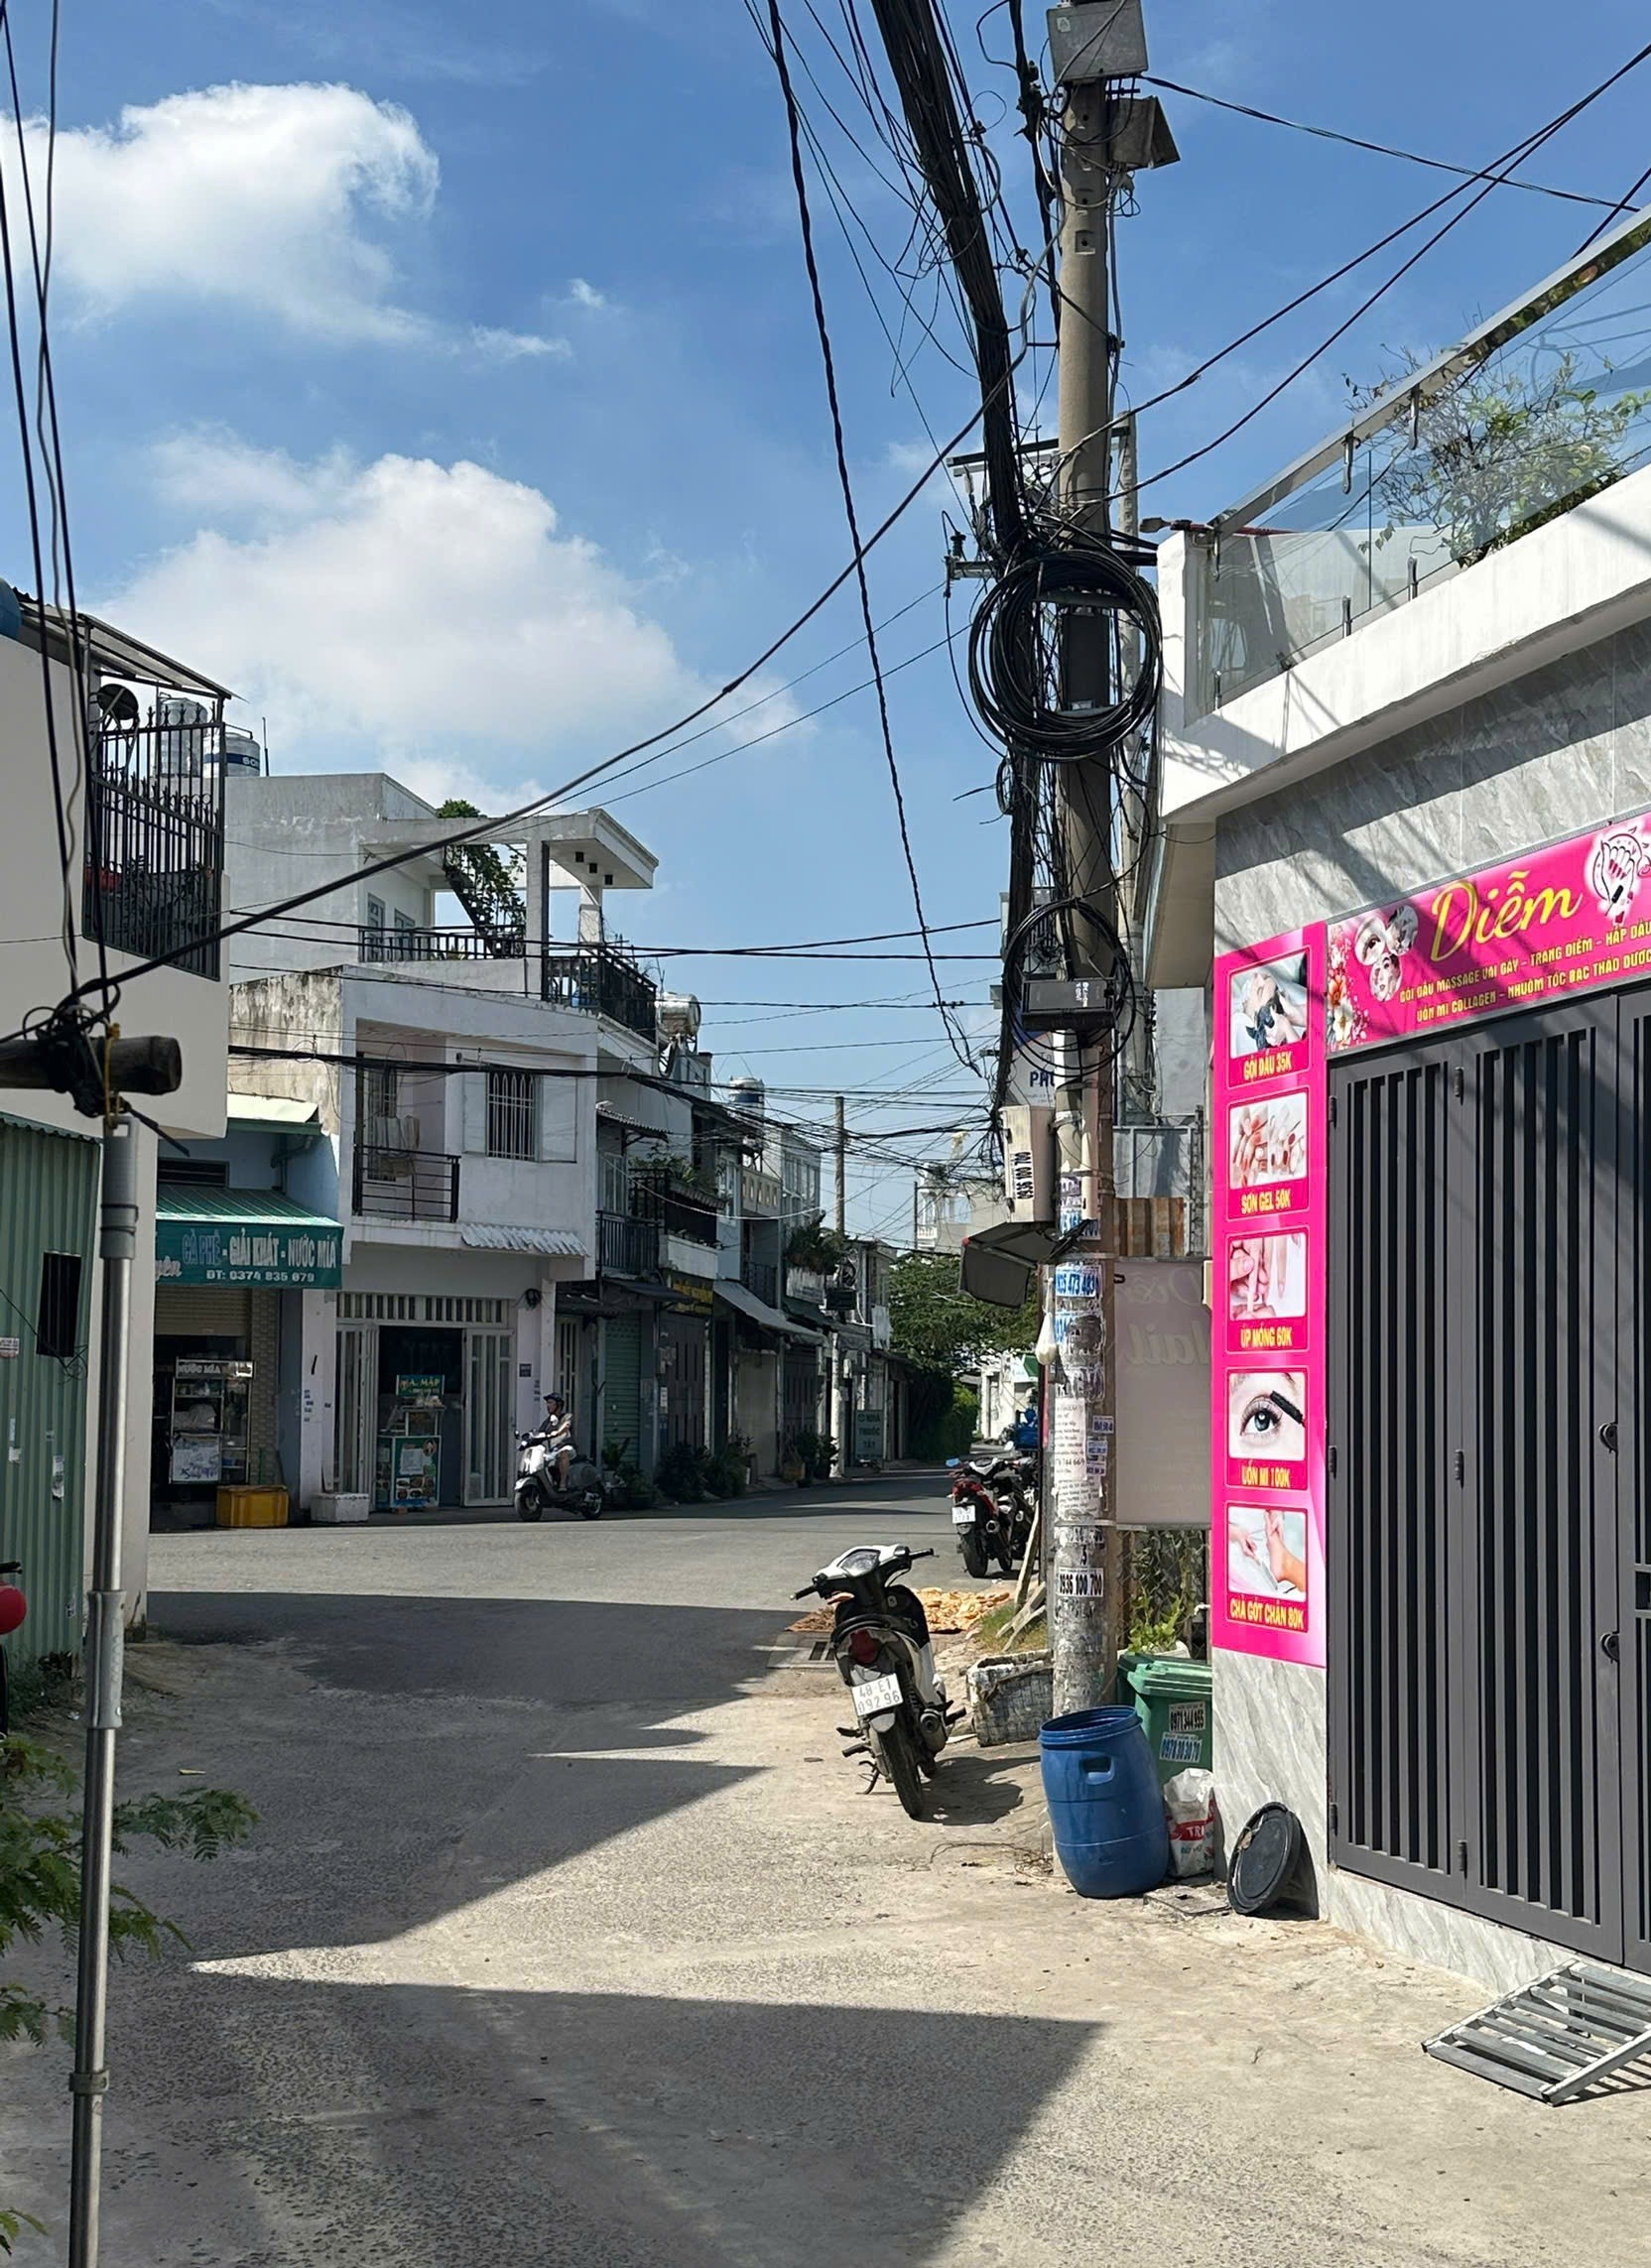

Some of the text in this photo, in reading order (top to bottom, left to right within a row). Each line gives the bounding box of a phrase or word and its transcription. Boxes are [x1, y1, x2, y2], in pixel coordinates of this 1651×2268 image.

[1431, 870, 1583, 961] Diễm
[1437, 969, 1480, 993] MASSAGE
[1482, 964, 1497, 980] VAI
[1530, 945, 1563, 967] TRANG
[1452, 991, 1496, 1013] COLLAGEN
[1259, 1191, 1275, 1212] GEL
[229, 1270, 261, 1281] 0374
